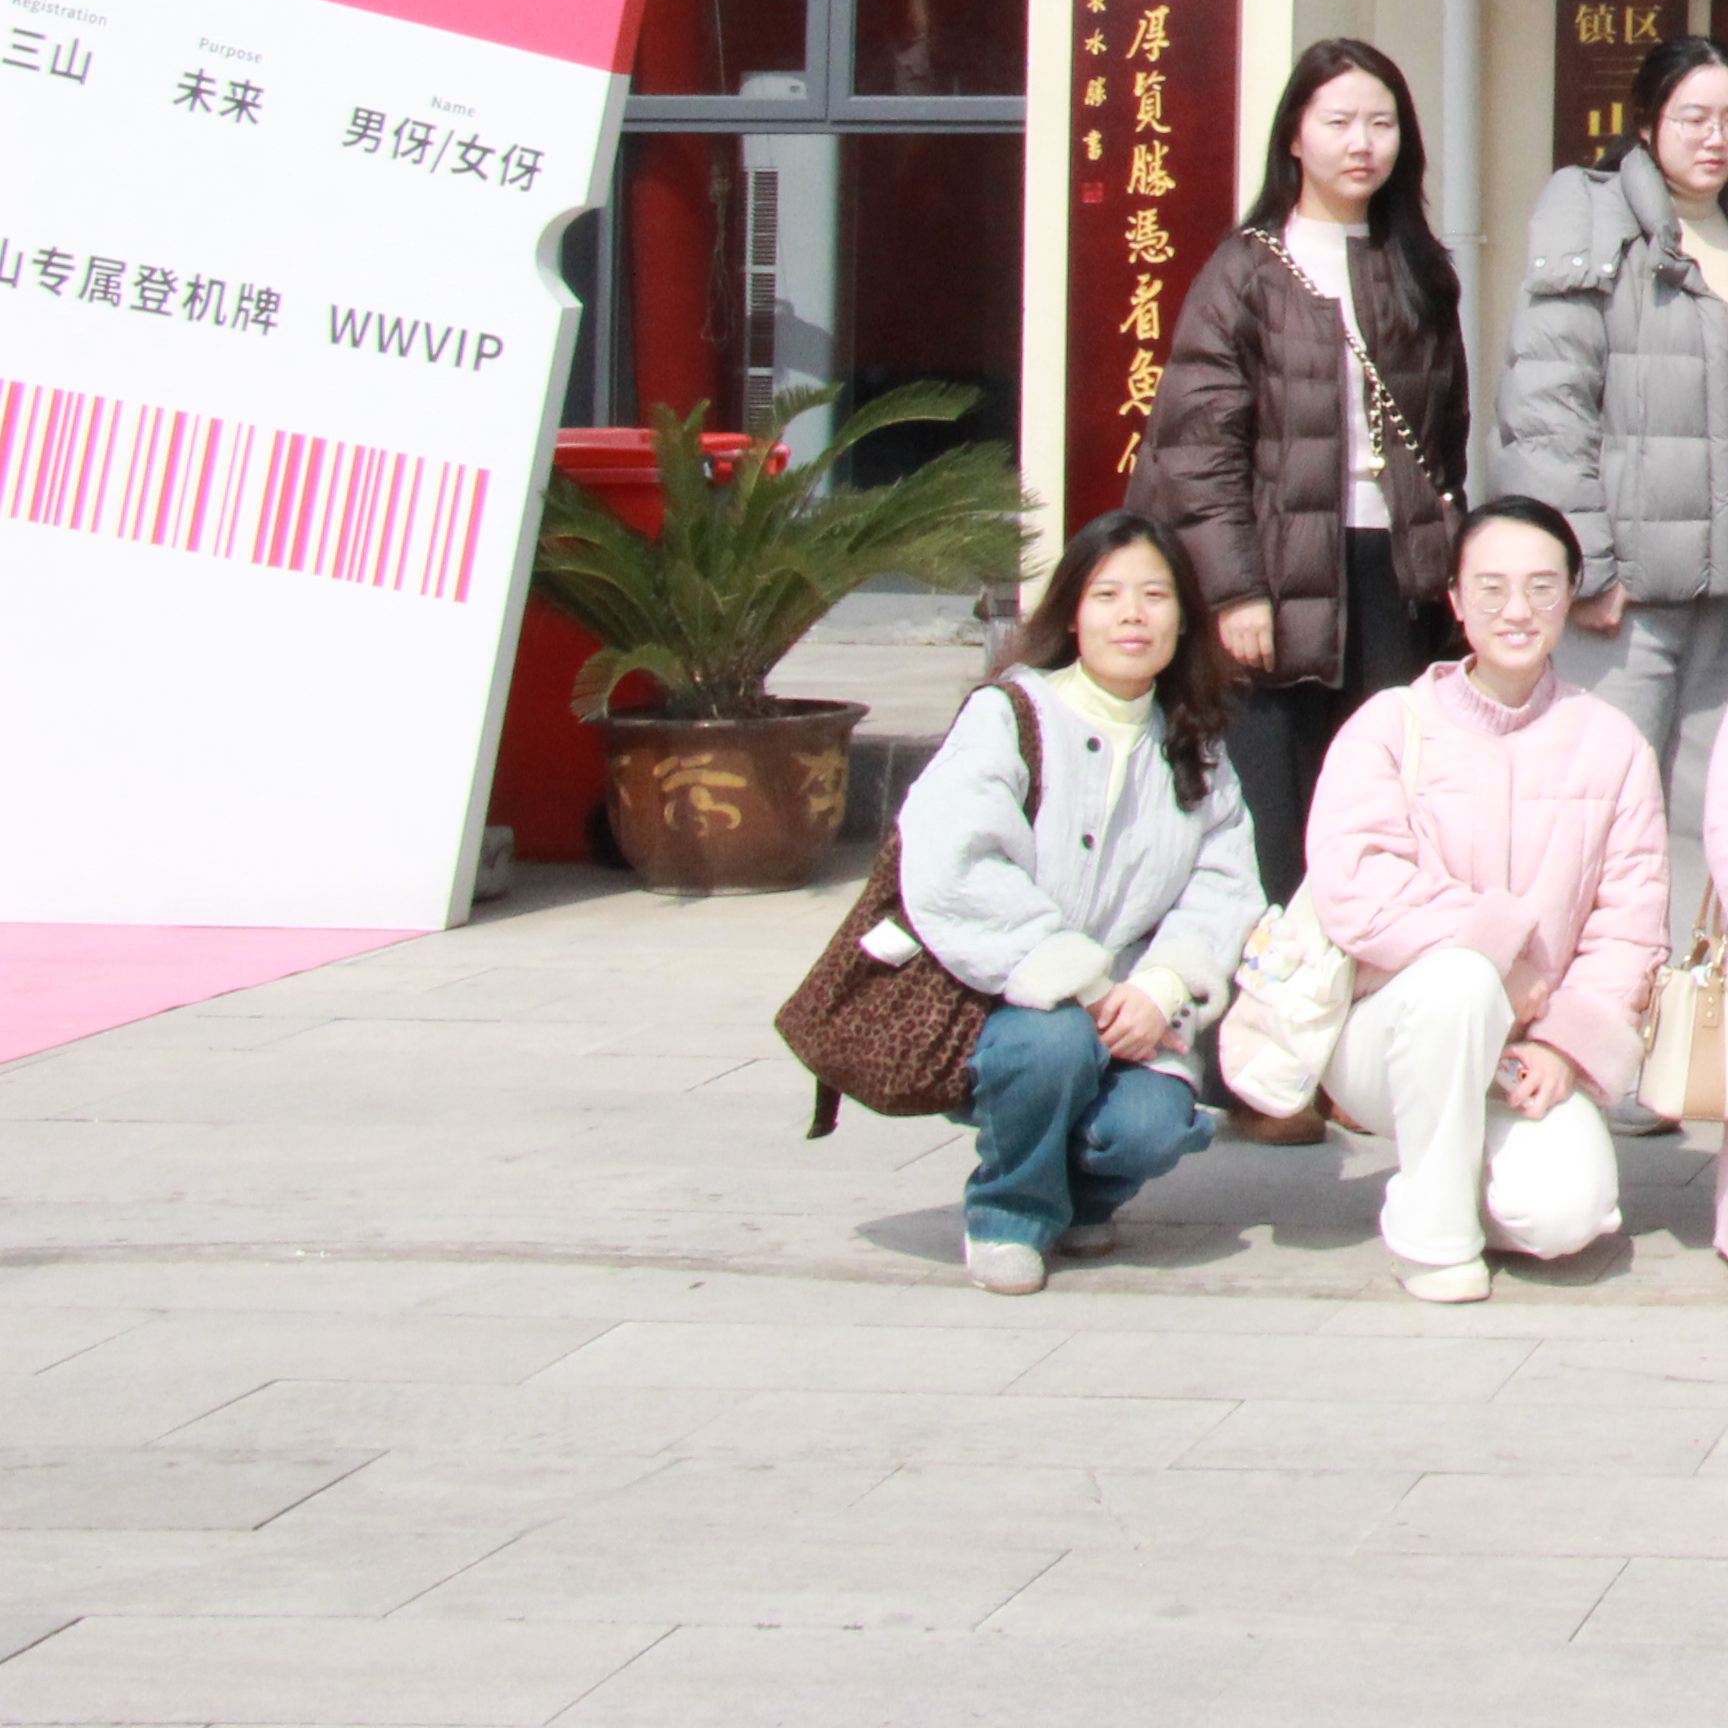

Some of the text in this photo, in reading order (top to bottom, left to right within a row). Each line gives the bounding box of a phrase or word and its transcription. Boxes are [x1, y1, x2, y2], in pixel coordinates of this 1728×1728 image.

[2, 27, 93, 86] 三山
[198, 37, 263, 65] Purpose
[172, 68, 265, 125] 未来
[430, 96, 477, 118] Name
[341, 106, 546, 192] 男伢/女伢
[330, 304, 505, 372] WWVIP
